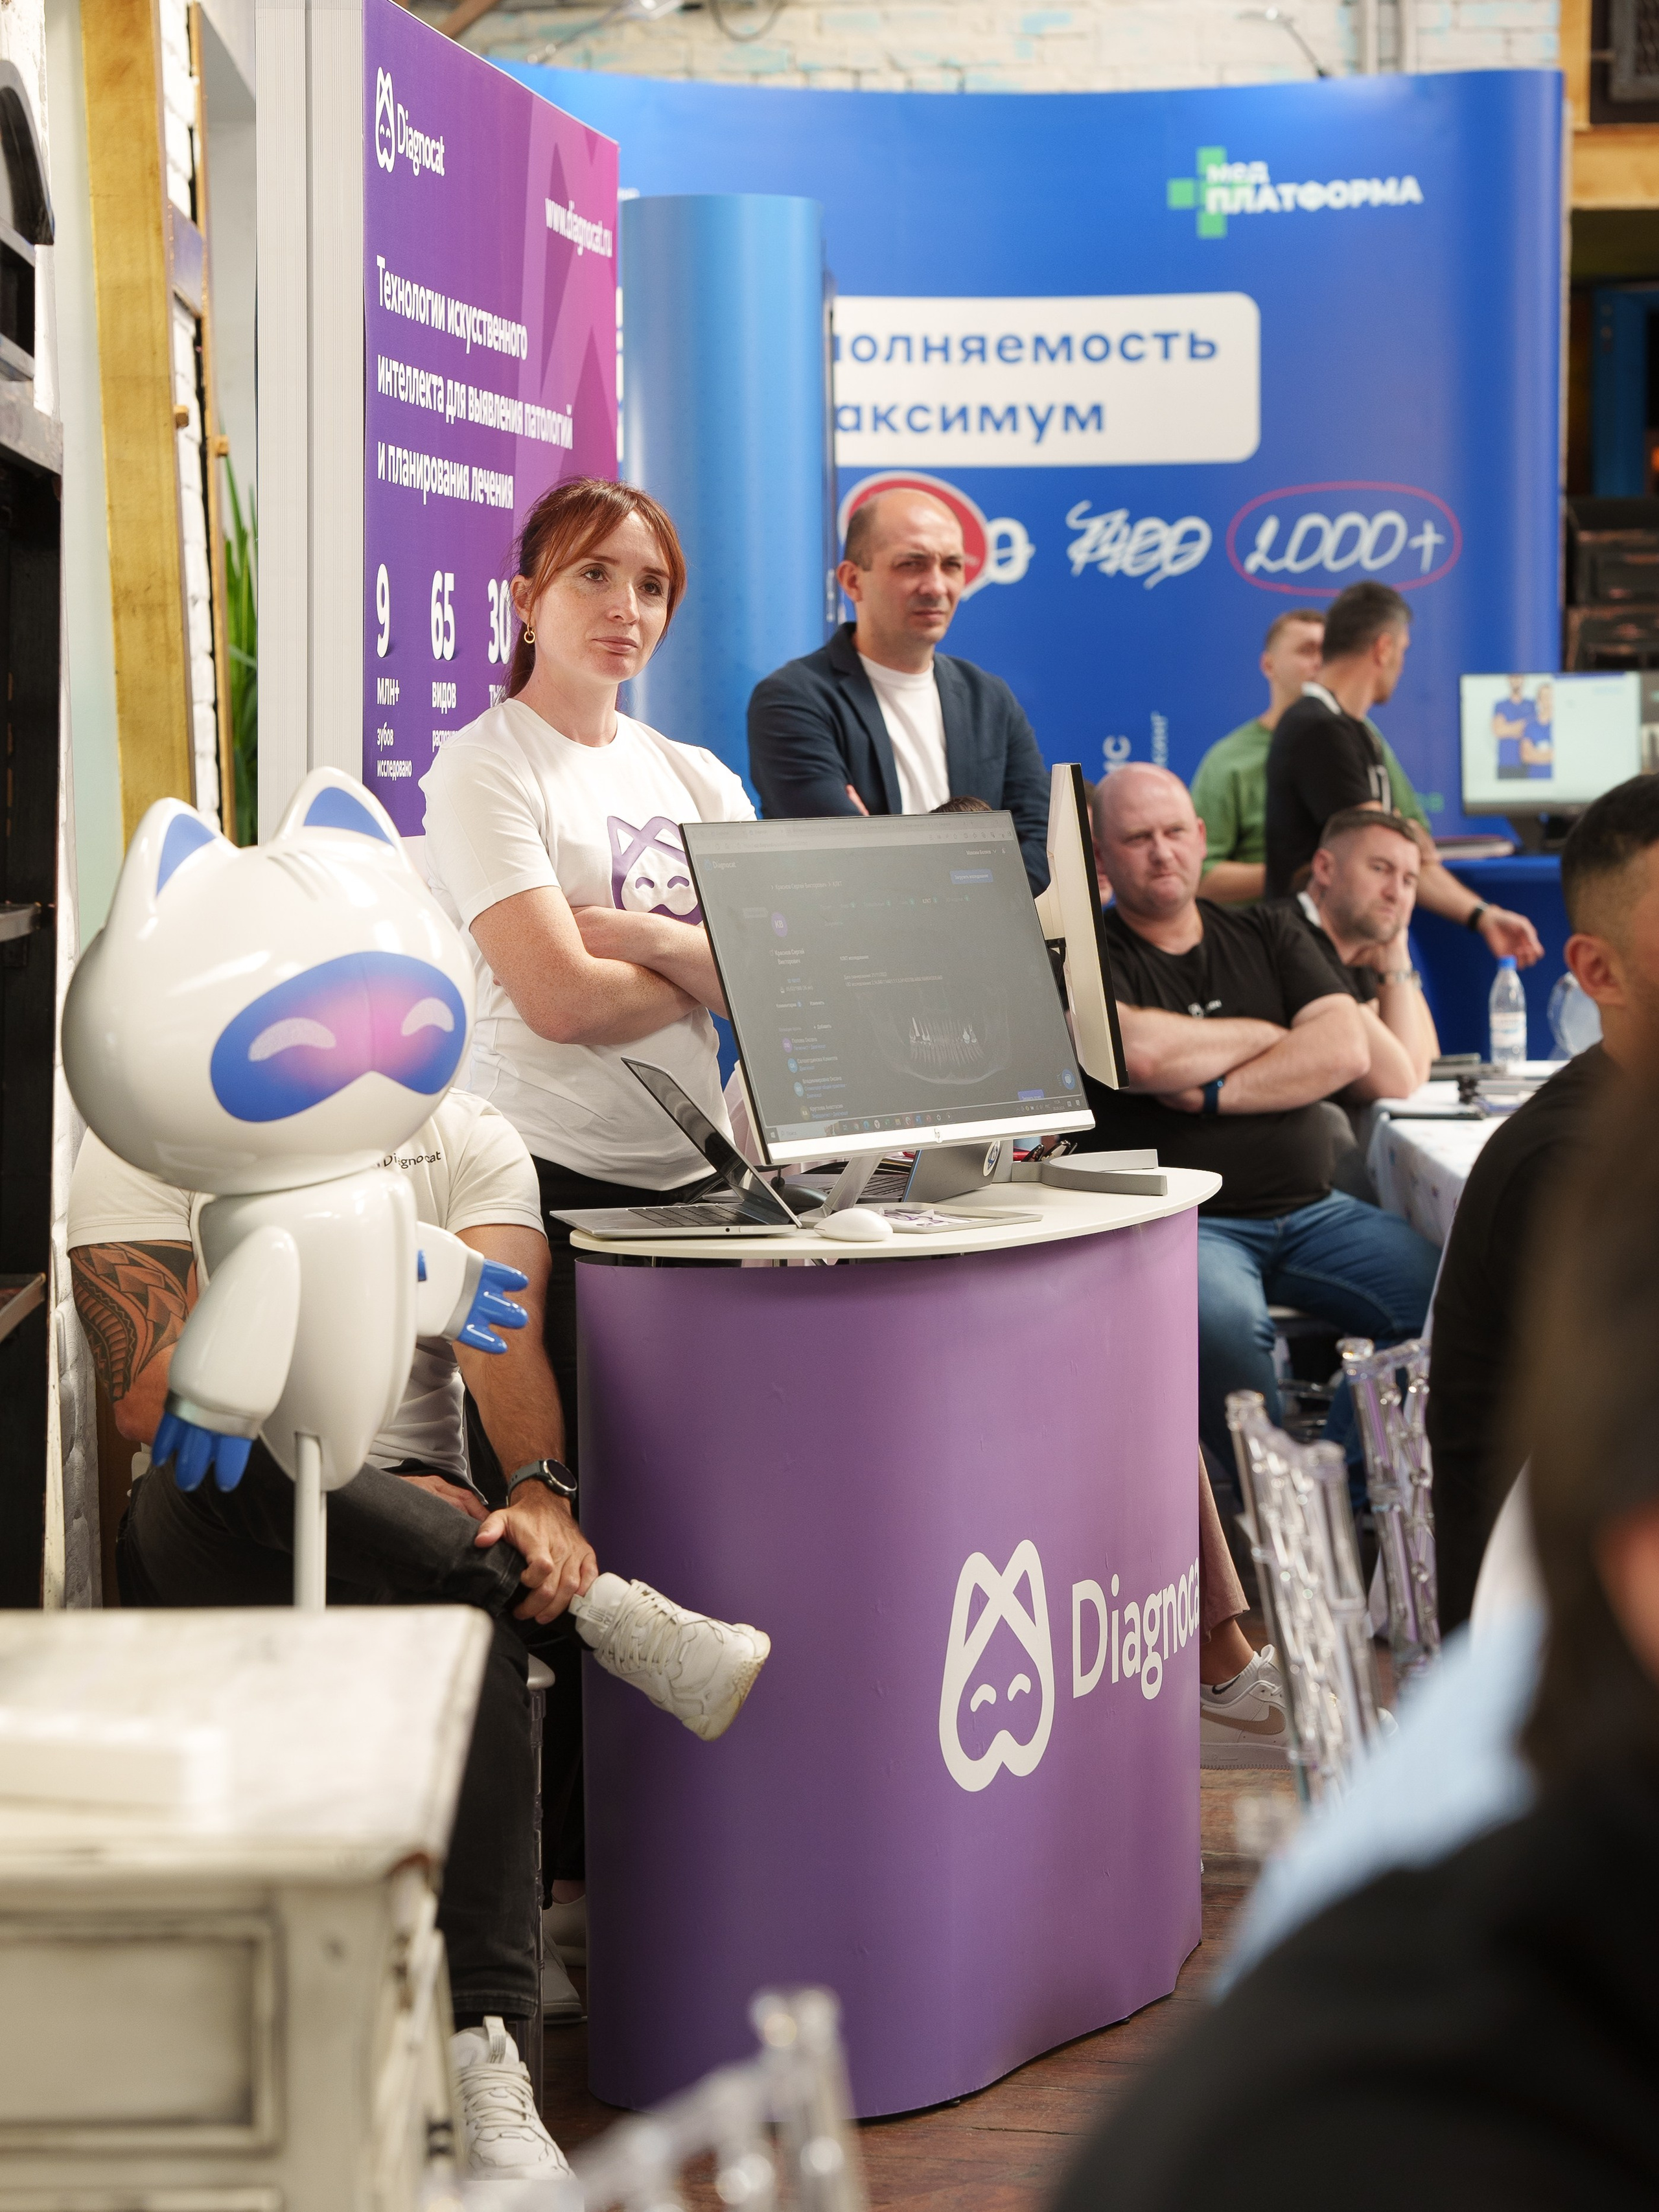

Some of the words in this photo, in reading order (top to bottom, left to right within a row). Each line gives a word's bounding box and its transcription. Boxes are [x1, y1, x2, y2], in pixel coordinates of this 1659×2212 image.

[397, 103, 445, 176] Diagnocat
[545, 198, 612, 258] www.diagnocat.ru
[1206, 175, 1424, 214] ПЛАТФОРМА
[377, 255, 445, 331] Технологии
[447, 297, 528, 360] искусственного
[377, 354, 445, 414] интеллекта
[446, 379, 466, 424] для
[468, 386, 523, 435] выявления
[524, 403, 573, 450] патологий
[377, 441, 386, 479] и
[388, 444, 469, 505] планирования
[470, 466, 513, 509] лечения
[377, 563, 389, 658] 9
[431, 570, 455, 660] 65
[377, 722, 394, 752] зубов
[377, 759, 412, 781] исследовано
[713, 860, 736, 869] Diagnocat
